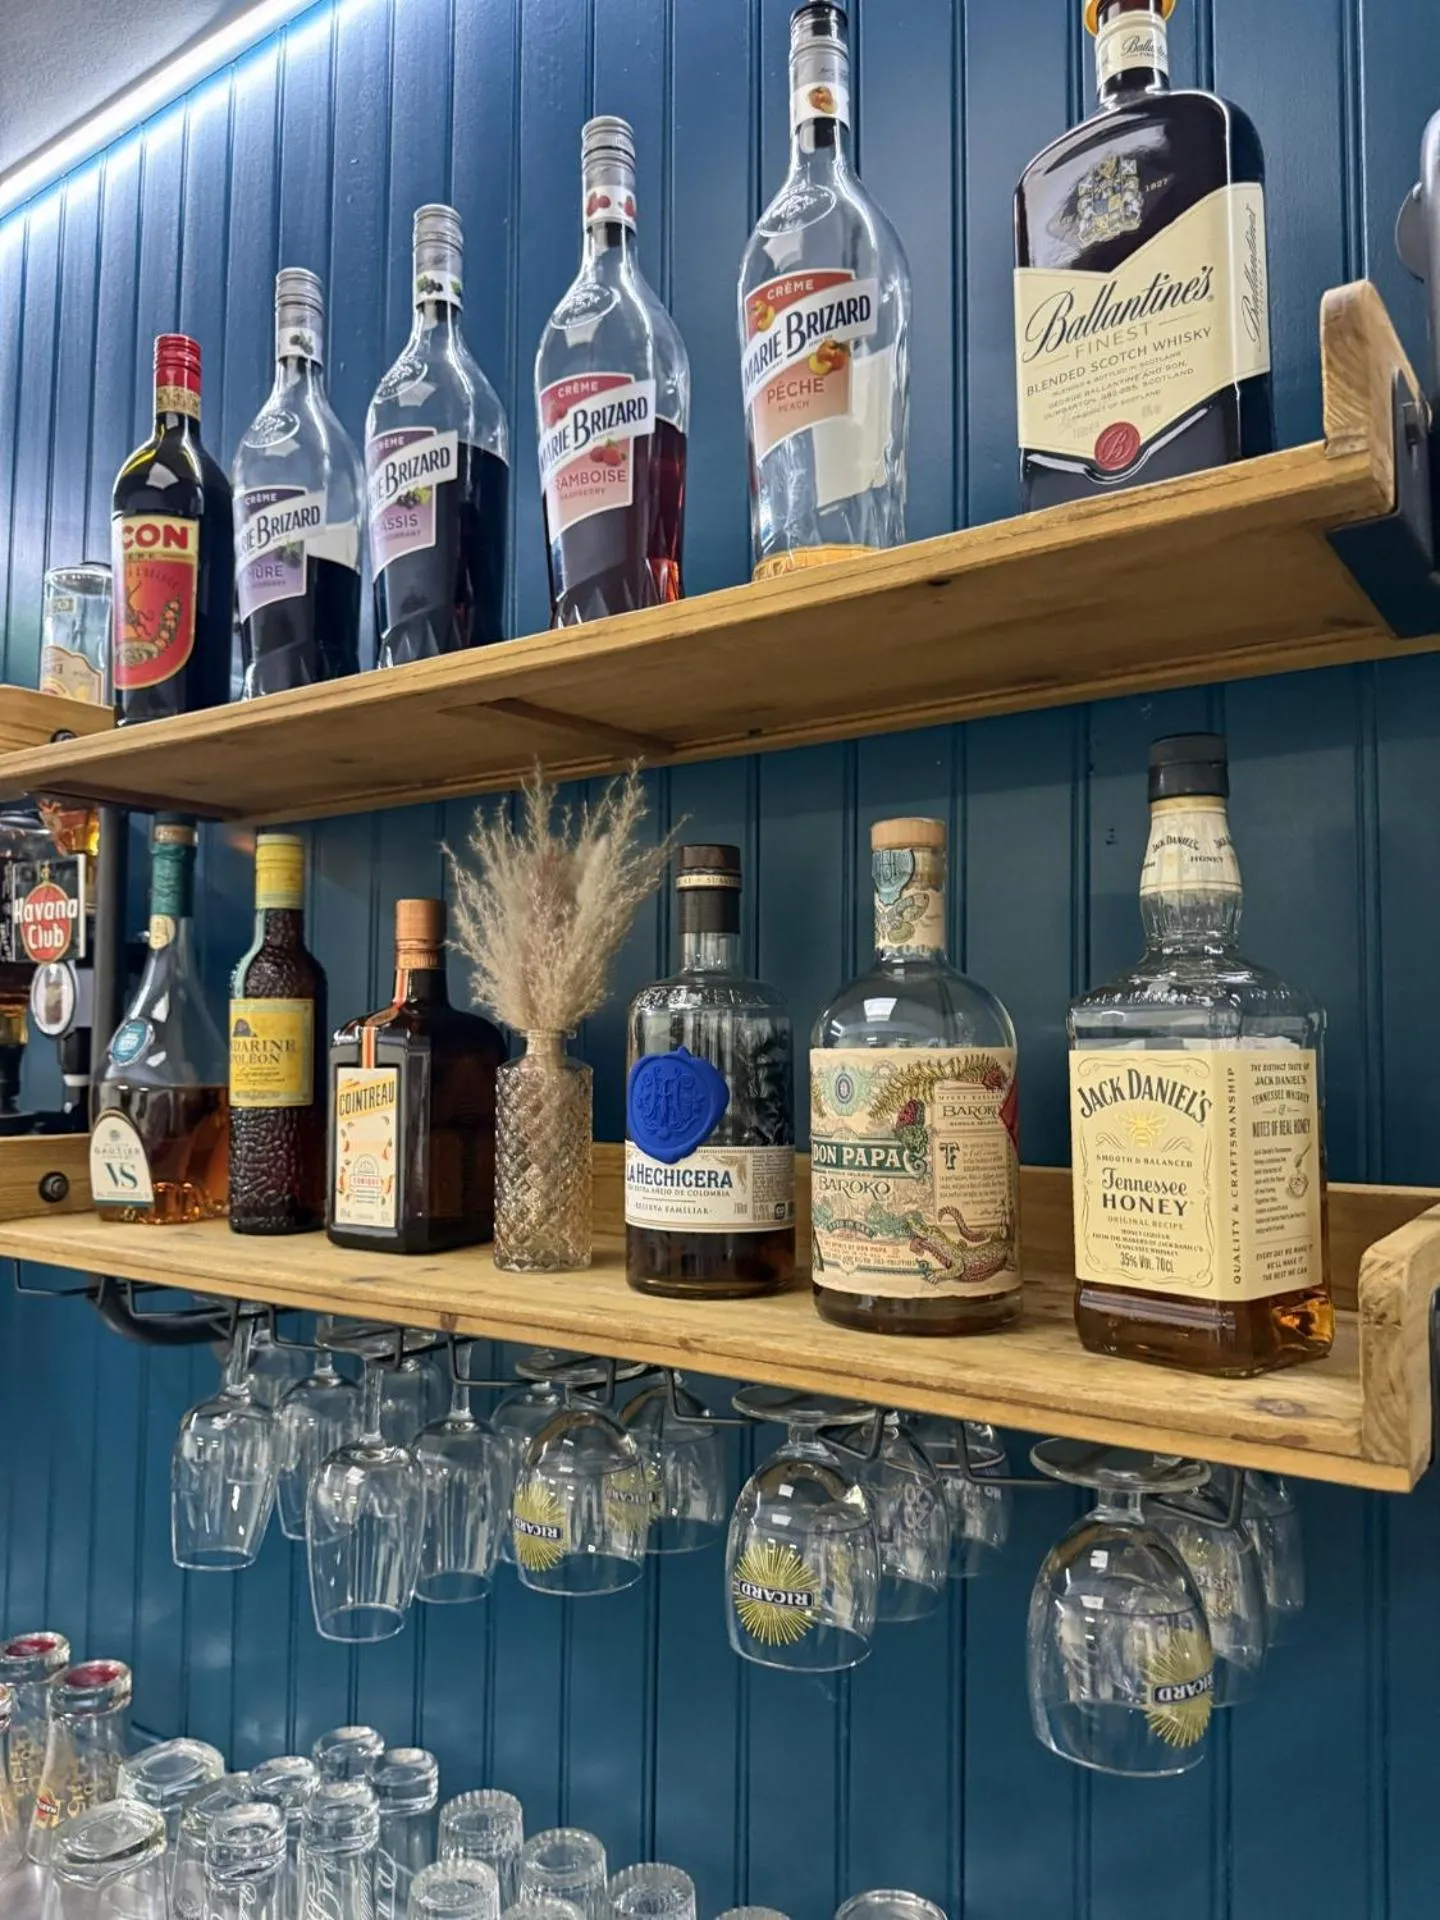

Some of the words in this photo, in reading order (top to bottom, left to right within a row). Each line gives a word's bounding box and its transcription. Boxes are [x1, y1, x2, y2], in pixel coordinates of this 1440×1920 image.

[1022, 265, 1214, 363] Ballantine's
[744, 330, 782, 386] MARIE
[786, 295, 871, 357] BRIZARD
[1075, 320, 1153, 360] FINEST
[1027, 365, 1086, 397] BLENDED
[1091, 345, 1147, 374] SCOTCH
[1153, 327, 1212, 352] WHISKY
[767, 378, 824, 404] PÊCHE
[778, 400, 810, 412] PEACH
[573, 397, 648, 451] BRIZARD
[385, 447, 451, 499] BRIZARD
[556, 470, 627, 490] RAMBOISE
[122, 523, 188, 550] CON
[257, 505, 320, 549] BRIZARD
[13, 897, 78, 923] Havana
[28, 923, 64, 950] Club
[1255, 1076, 1274, 1086] JACK
[338, 1080, 395, 1116] COINTREAU
[1077, 1076, 1126, 1118] JACK
[1127, 1068, 1213, 1124] DANIEL'S
[943, 1105, 997, 1120] BAROK
[1227, 1067, 1239, 1198] CRAFTSMANSHIP
[1252, 1121, 1270, 1138] NOTES
[1271, 1120, 1278, 1136] OF
[1279, 1120, 1293, 1137] REAL
[1294, 1118, 1311, 1135] HONEY
[813, 1143, 836, 1165] DON
[842, 1146, 901, 1168] PAPA
[1096, 1154, 1133, 1164] SMOOTH
[1143, 1158, 1193, 1168] BALANCED
[104, 1162, 138, 1189] VS
[637, 1163, 733, 1189] HECHICERA
[820, 1176, 891, 1200] BAROKO
[1101, 1167, 1188, 1196] Tennessee
[1102, 1193, 1188, 1217] HONEY
[1120, 1251, 1138, 1268] 35%
[1232, 1219, 1241, 1284] QUALITY
[515, 1518, 558, 1538] RICARD
[741, 1583, 808, 1606] RICARD
[1158, 1674, 1213, 1701] RICARD
